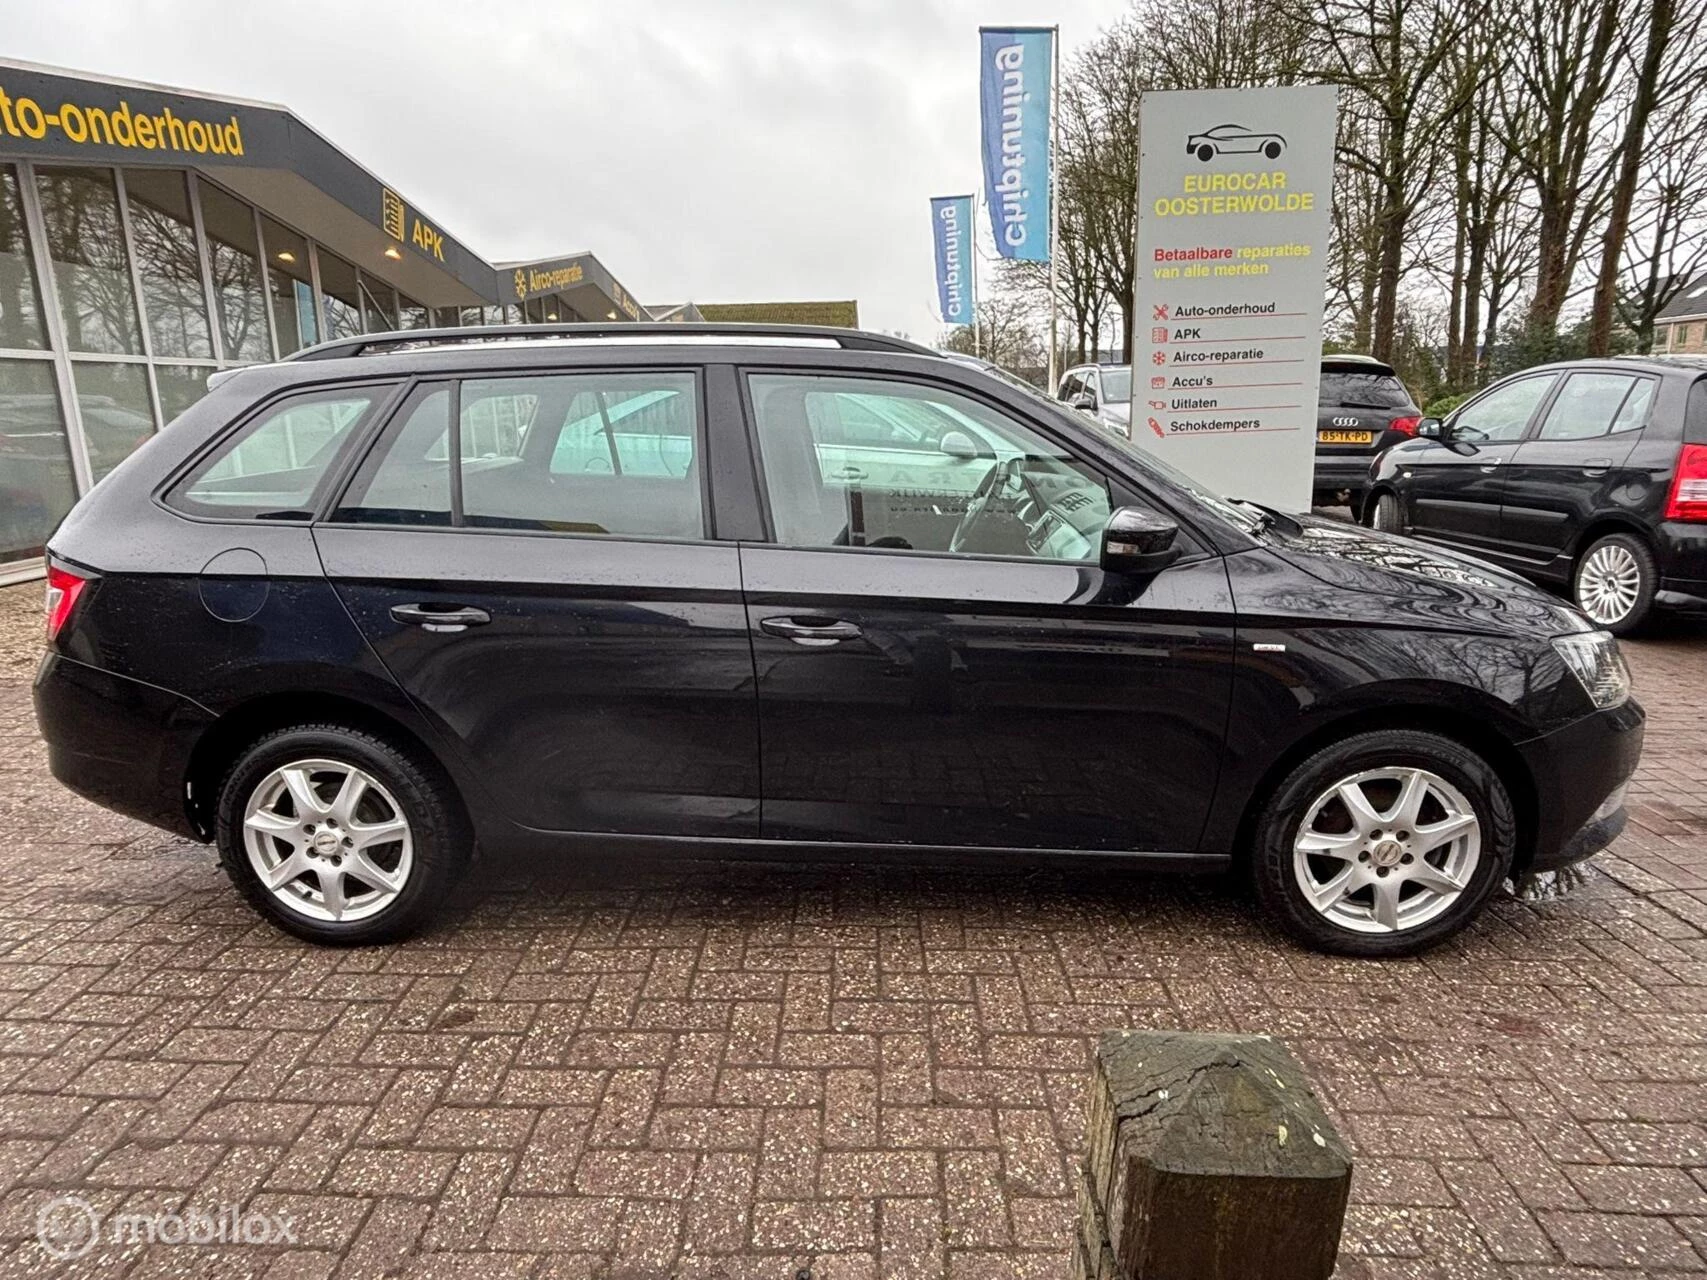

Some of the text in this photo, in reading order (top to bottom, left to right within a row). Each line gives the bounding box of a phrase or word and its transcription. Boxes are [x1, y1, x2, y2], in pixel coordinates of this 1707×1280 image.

[0, 86, 244, 156] to-onderhoud
[1184, 171, 1286, 193] EUROCAR
[1154, 193, 1314, 216] OOSTERWOLDE
[412, 219, 445, 262] APK
[1154, 243, 1312, 261] Betaalbare reparaties
[530, 261, 584, 292] Airco-reparatie
[1153, 263, 1269, 278] van alle merken
[1175, 302, 1276, 317] Auto-onderhoud
[1174, 328, 1201, 340] APK
[1173, 348, 1264, 363] Airco-reparatie
[1172, 376, 1213, 387] Accu's
[1171, 398, 1217, 410] Uitlaten
[1170, 418, 1261, 432] Schokdempers
[1321, 431, 1369, 441] 85-TK-PD
